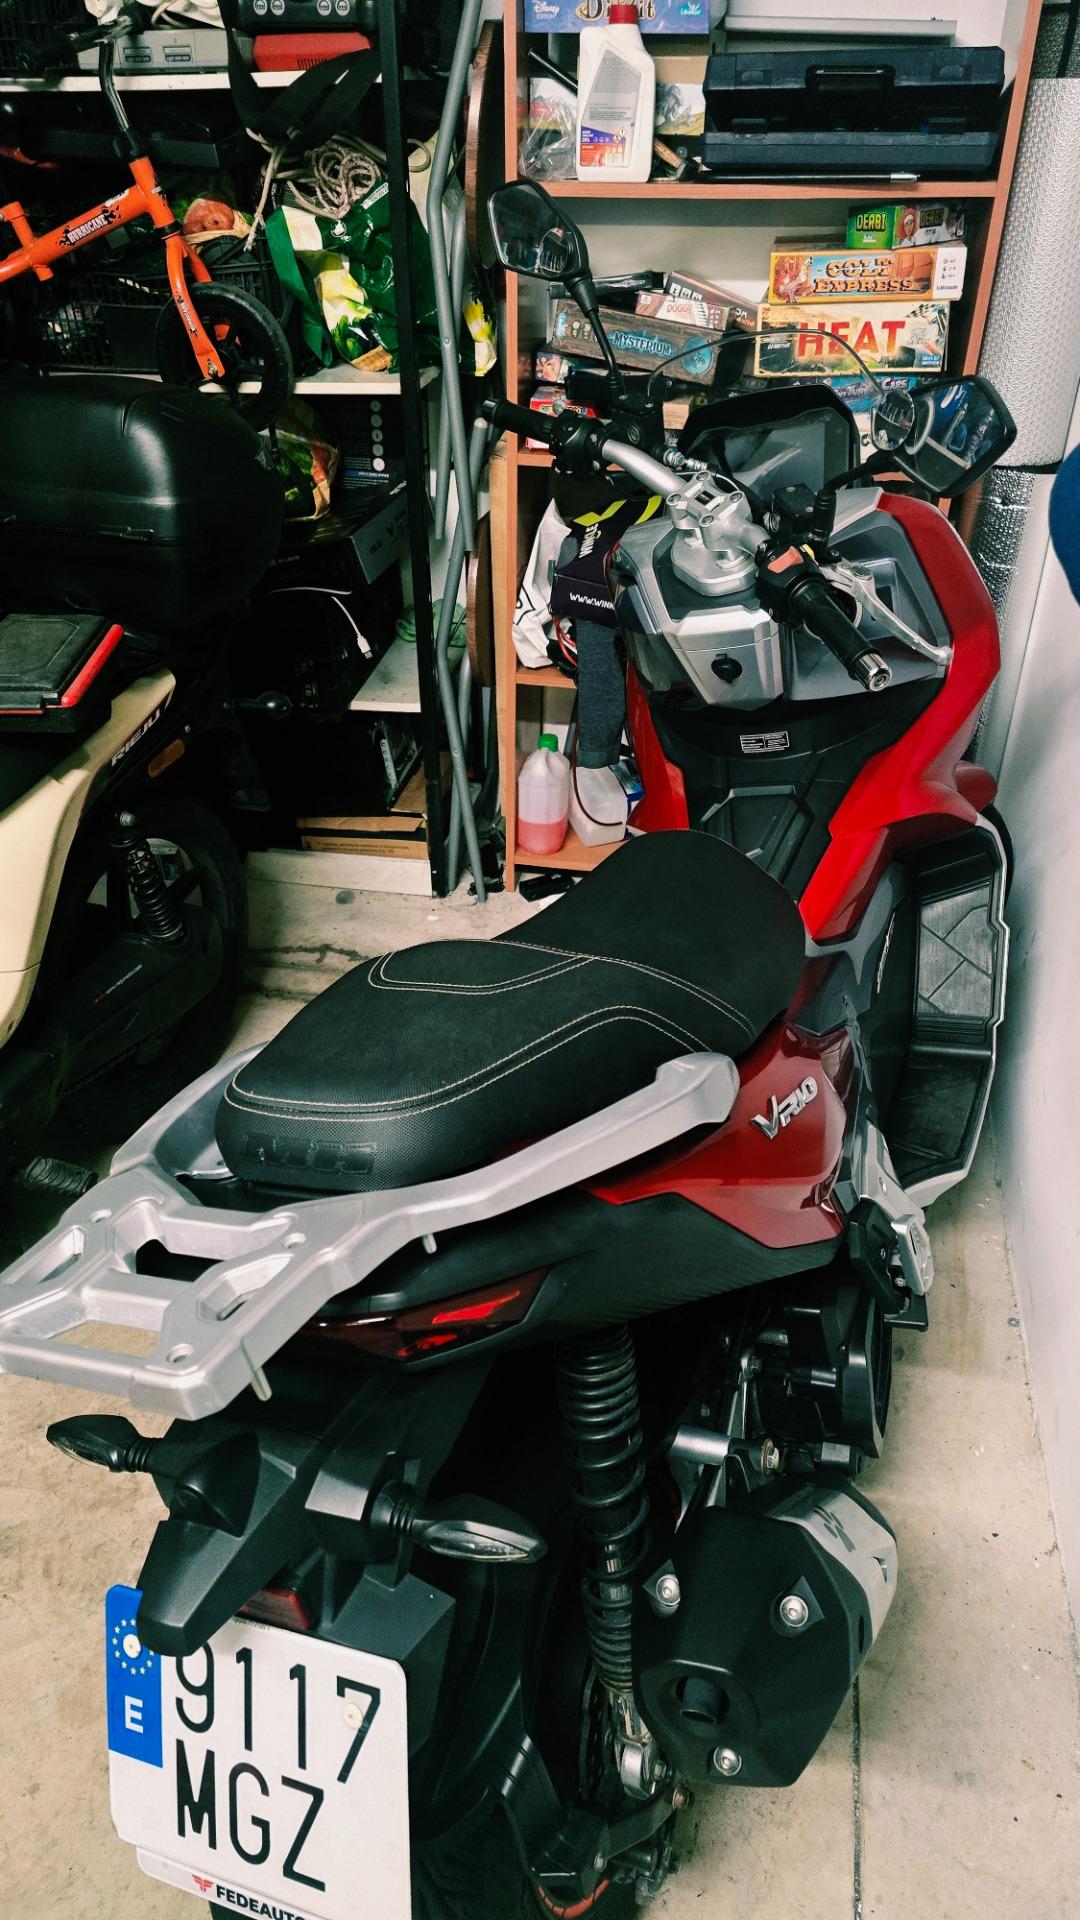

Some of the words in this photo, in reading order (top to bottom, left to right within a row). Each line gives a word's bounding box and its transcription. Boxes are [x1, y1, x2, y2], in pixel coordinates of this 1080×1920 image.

[576, 0, 656, 21] Diit
[66, 213, 109, 243] HURRICANE
[826, 257, 893, 278] COLT
[813, 278, 920, 293] EXPRESS
[613, 331, 672, 357] MYSTERIUM
[797, 320, 906, 358] HEAT
[111, 709, 160, 767] RIEJU
[125, 1695, 144, 1734] E
[175, 1641, 381, 1785] 9117
[176, 1738, 327, 1893] MGZ
